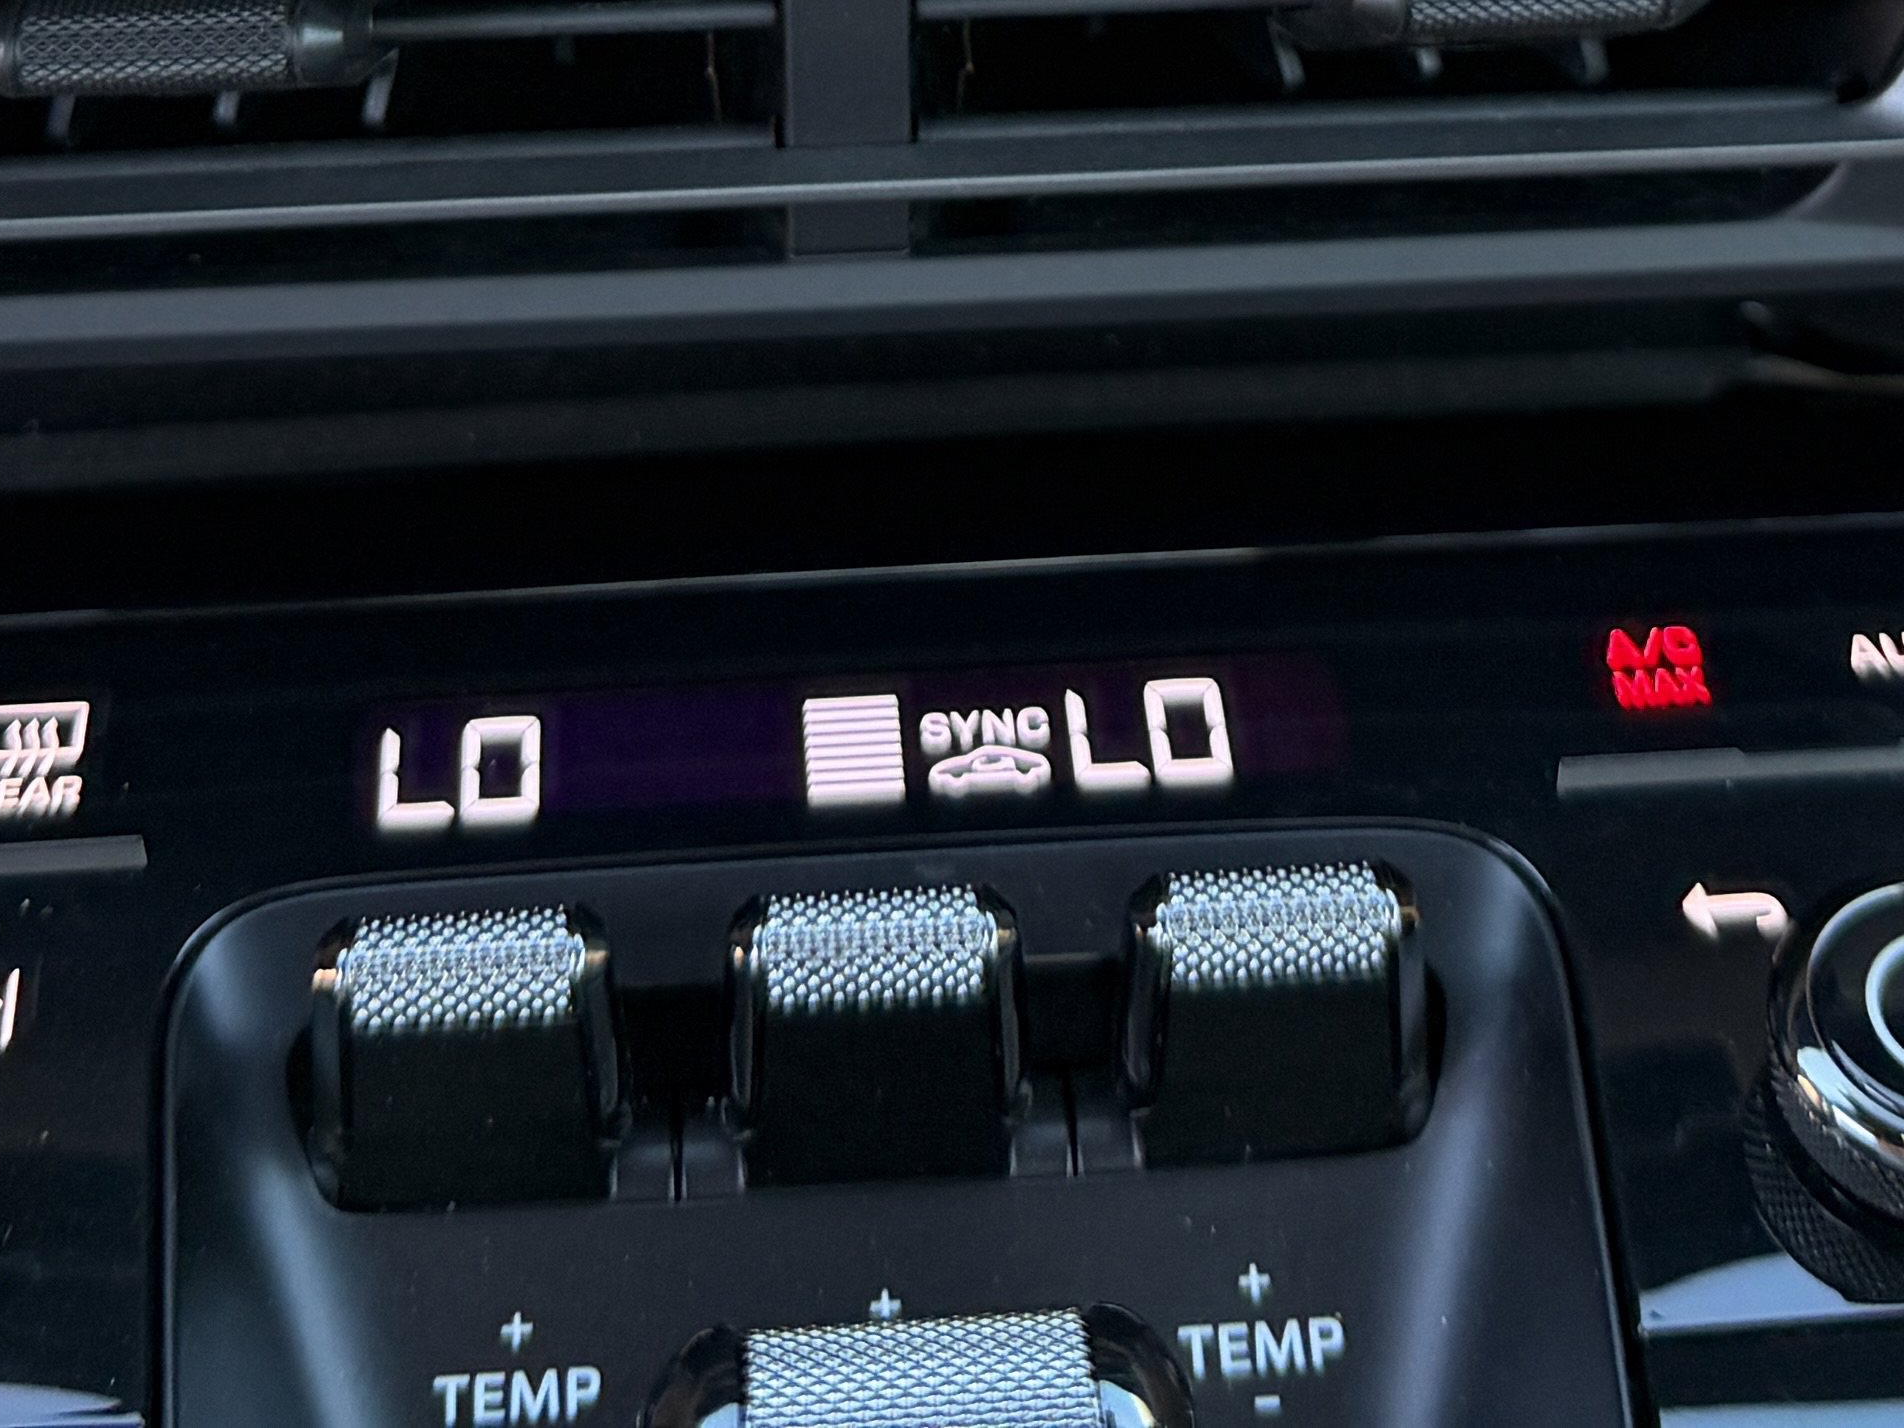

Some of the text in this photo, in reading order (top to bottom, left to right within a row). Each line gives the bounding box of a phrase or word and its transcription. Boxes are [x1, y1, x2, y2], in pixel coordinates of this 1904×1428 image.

[1612, 666, 1712, 711] MAX
[919, 705, 1051, 749] SYNC
[1064, 676, 1234, 794] LO
[377, 714, 542, 834] LO
[1177, 1316, 1344, 1379] TEMP
[433, 1367, 602, 1428] TEMP
